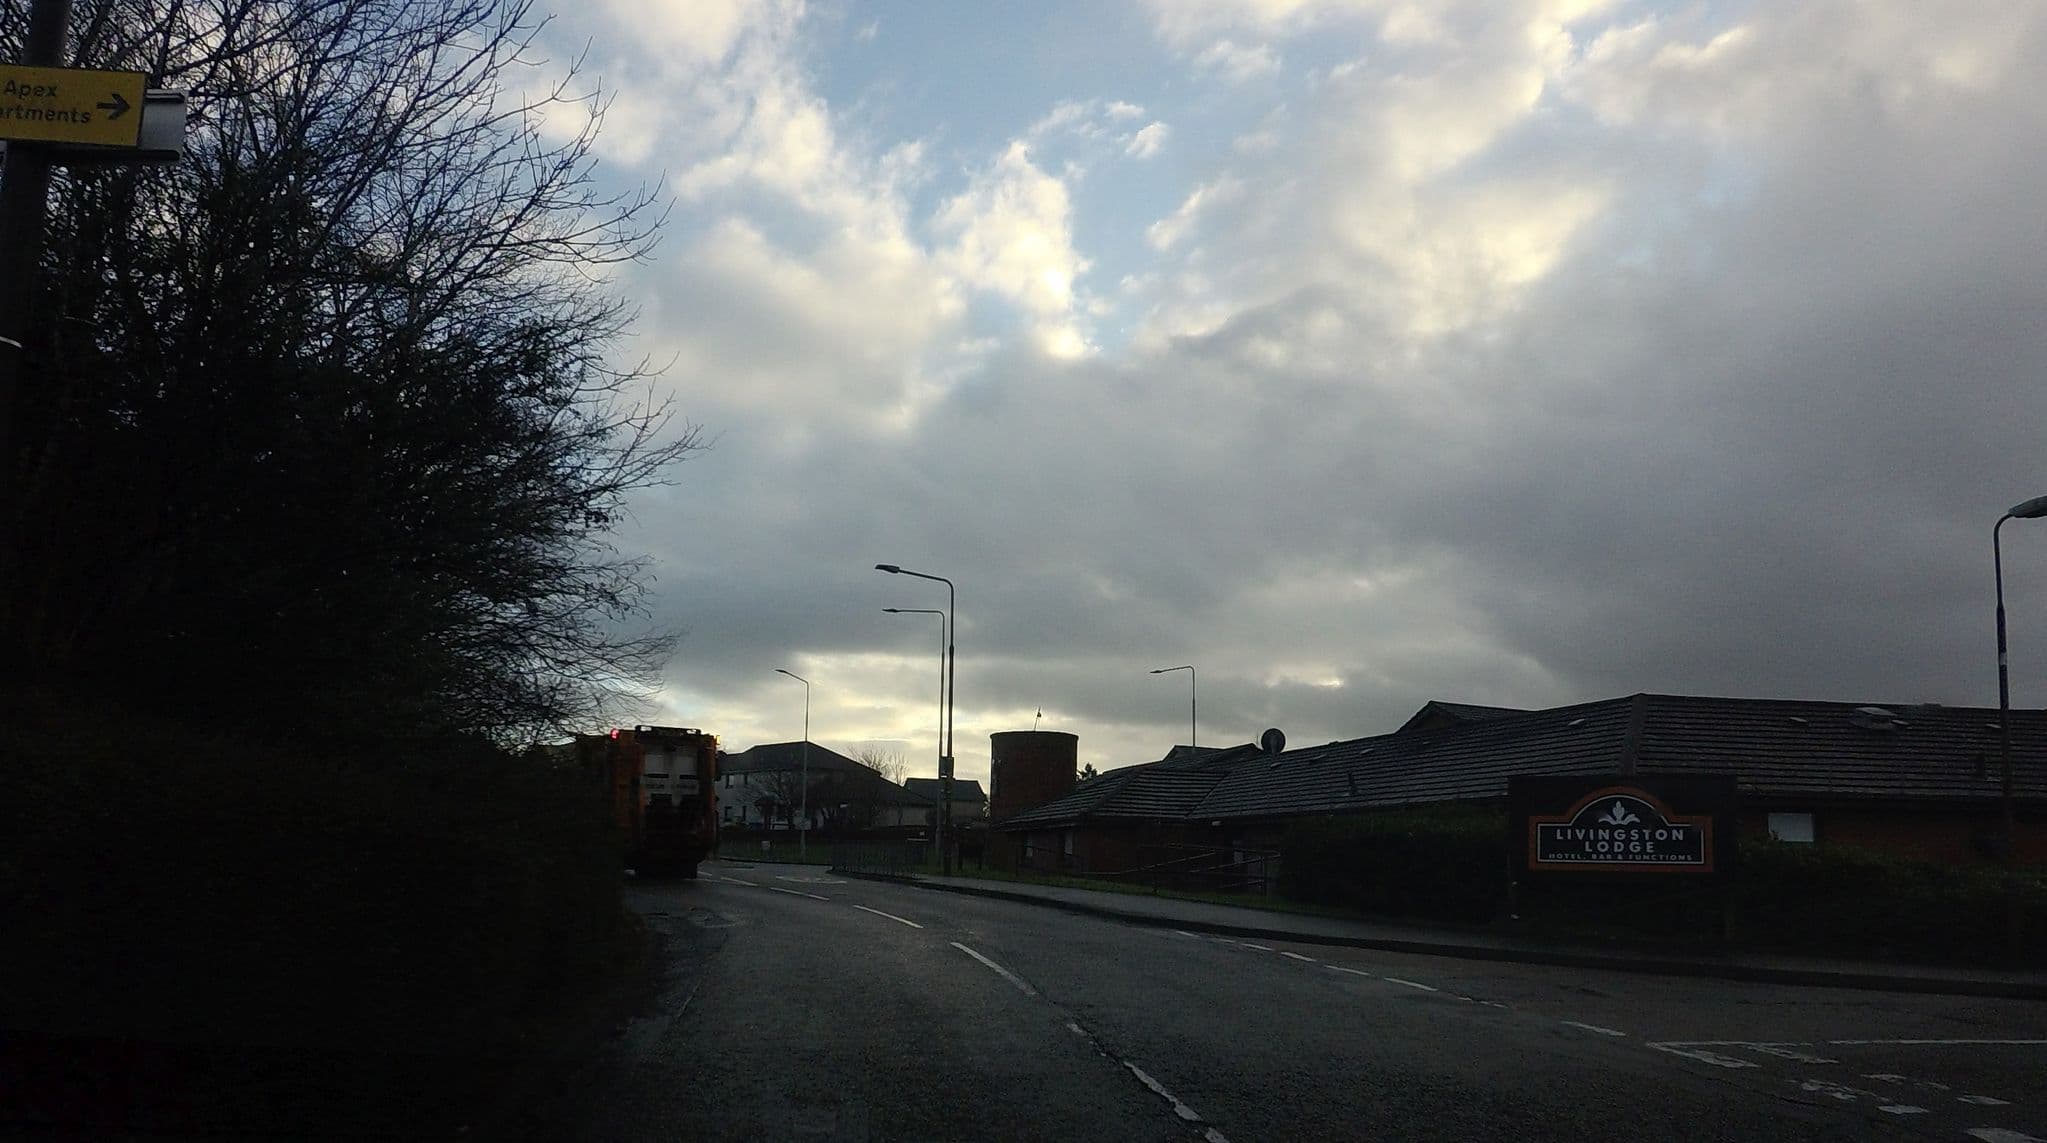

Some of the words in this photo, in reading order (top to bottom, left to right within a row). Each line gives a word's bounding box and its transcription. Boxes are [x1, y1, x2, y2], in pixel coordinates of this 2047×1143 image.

[4, 79, 58, 100] Apex
[1556, 828, 1684, 841] LIVINGSTON
[1584, 841, 1655, 853] LODGE
[1616, 853, 1624, 861] &
[1628, 853, 1694, 861] FUNCTIONS
